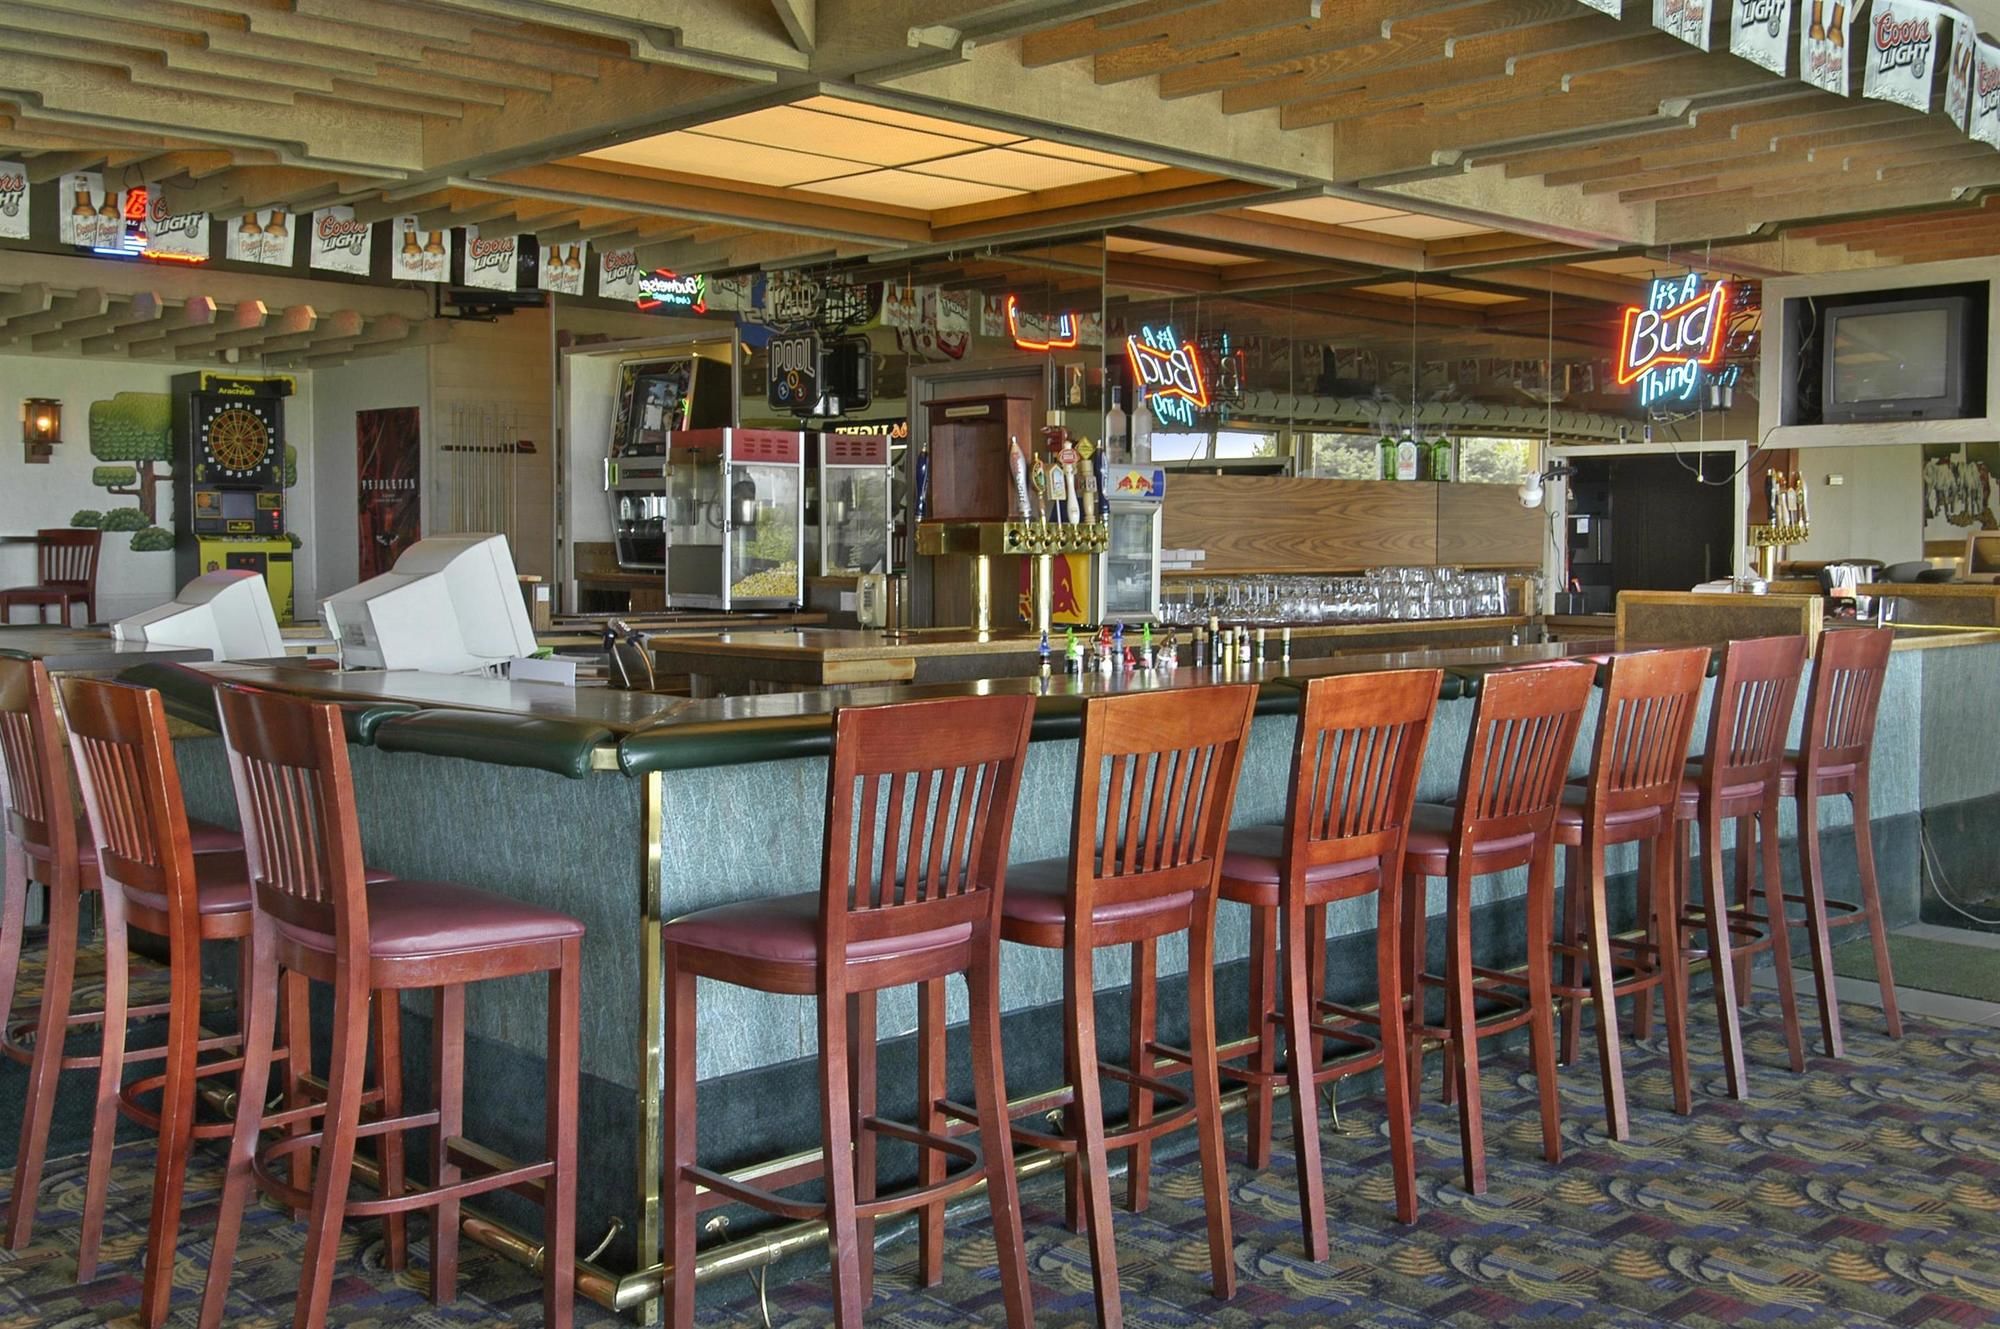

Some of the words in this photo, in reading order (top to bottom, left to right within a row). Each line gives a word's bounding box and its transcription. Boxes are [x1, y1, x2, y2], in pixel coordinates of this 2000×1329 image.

[1741, 0, 1785, 28] LIGHT
[1874, 9, 1931, 51] Coors
[1879, 43, 1930, 74] LIGHT
[154, 211, 203, 236] LIGHT
[318, 214, 368, 240] Coors
[321, 233, 366, 253] LIGHT
[469, 236, 514, 260] Coors
[474, 252, 513, 272] LIGHT
[606, 264, 637, 284] LIGHT
[1650, 279, 1676, 311] It's
[1679, 272, 1696, 304] A
[1629, 279, 1725, 368] Bud
[772, 338, 816, 382] POOL
[1636, 359, 1698, 407] Thing
